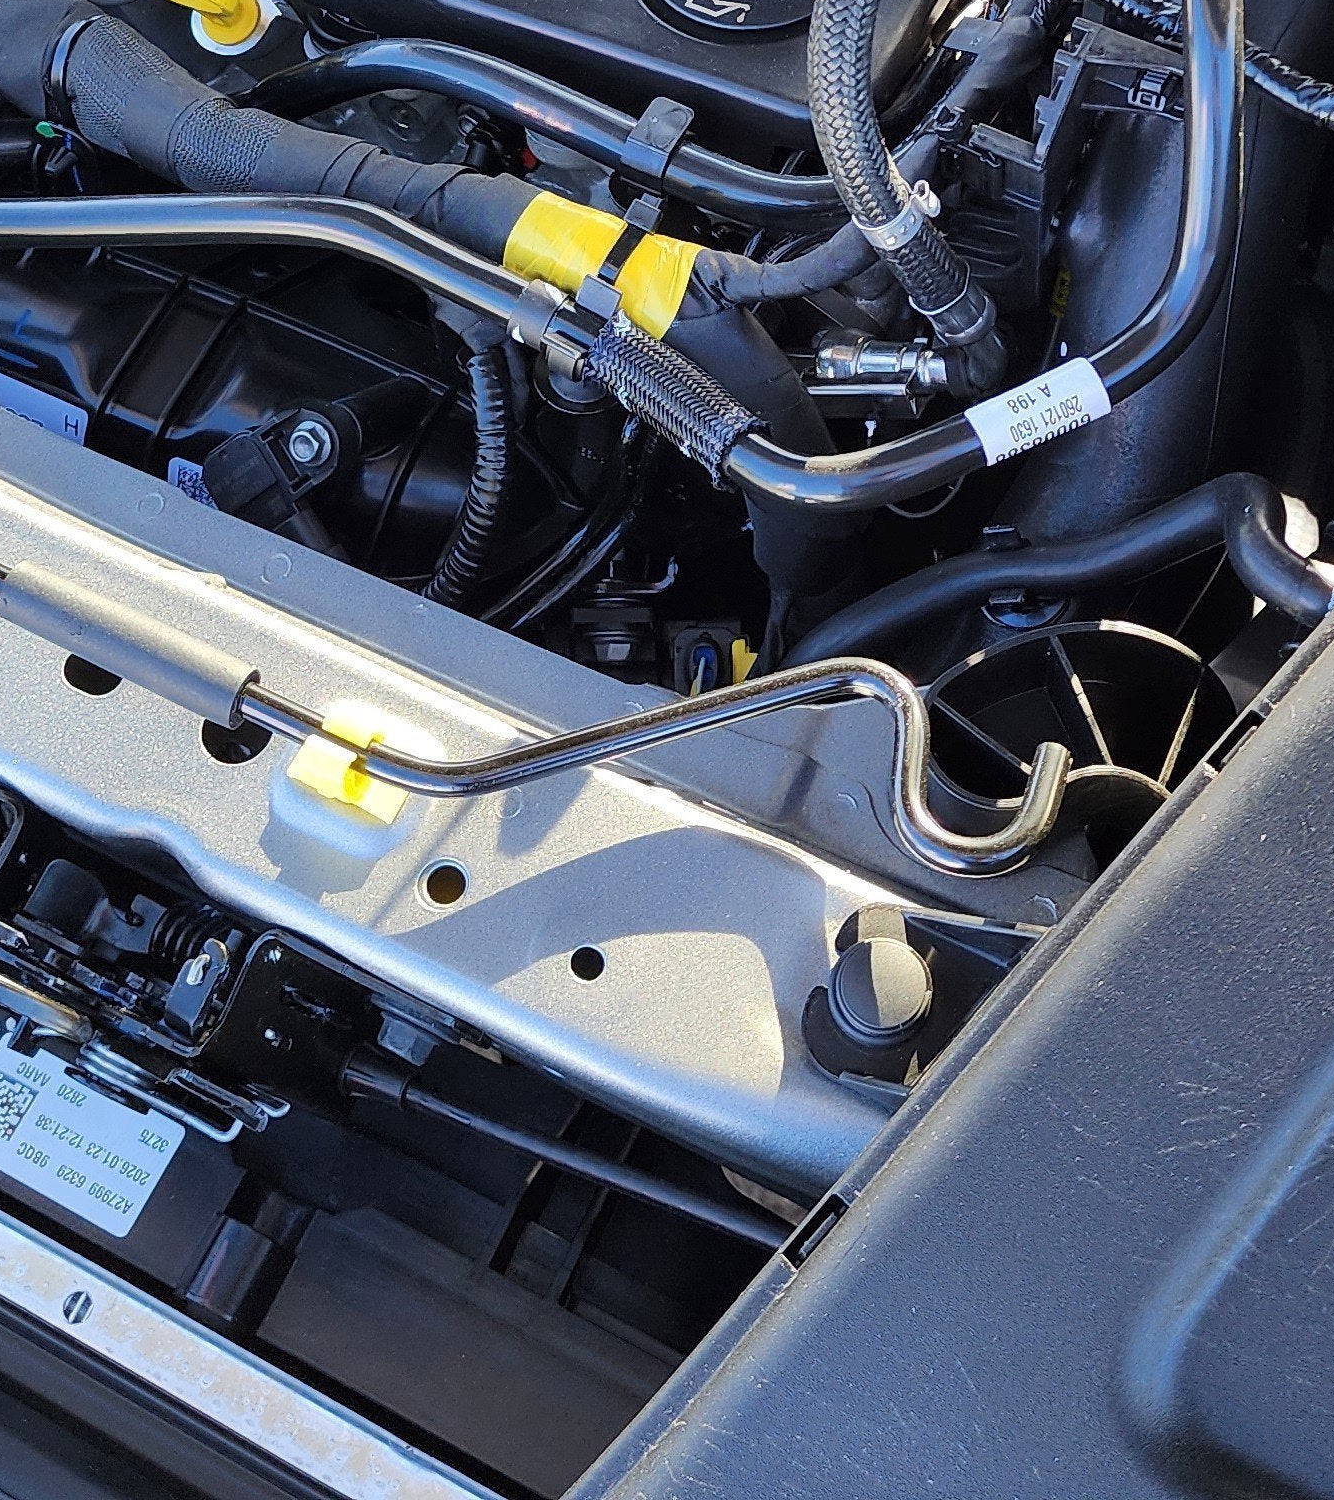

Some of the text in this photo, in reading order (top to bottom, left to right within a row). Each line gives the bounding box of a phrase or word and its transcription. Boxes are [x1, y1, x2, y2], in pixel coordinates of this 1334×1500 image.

[1007, 383, 1052, 413] A 198
[1040, 395, 1083, 428] 260121
[64, 414, 79, 437] H
[1010, 416, 1038, 442] 1630
[35, 1114, 150, 1185] 2026.01.23 12:21:38
[139, 1128, 169, 1152] 3275
[56, 1164, 87, 1188] 6329
[87, 1182, 133, 1214] A27999
